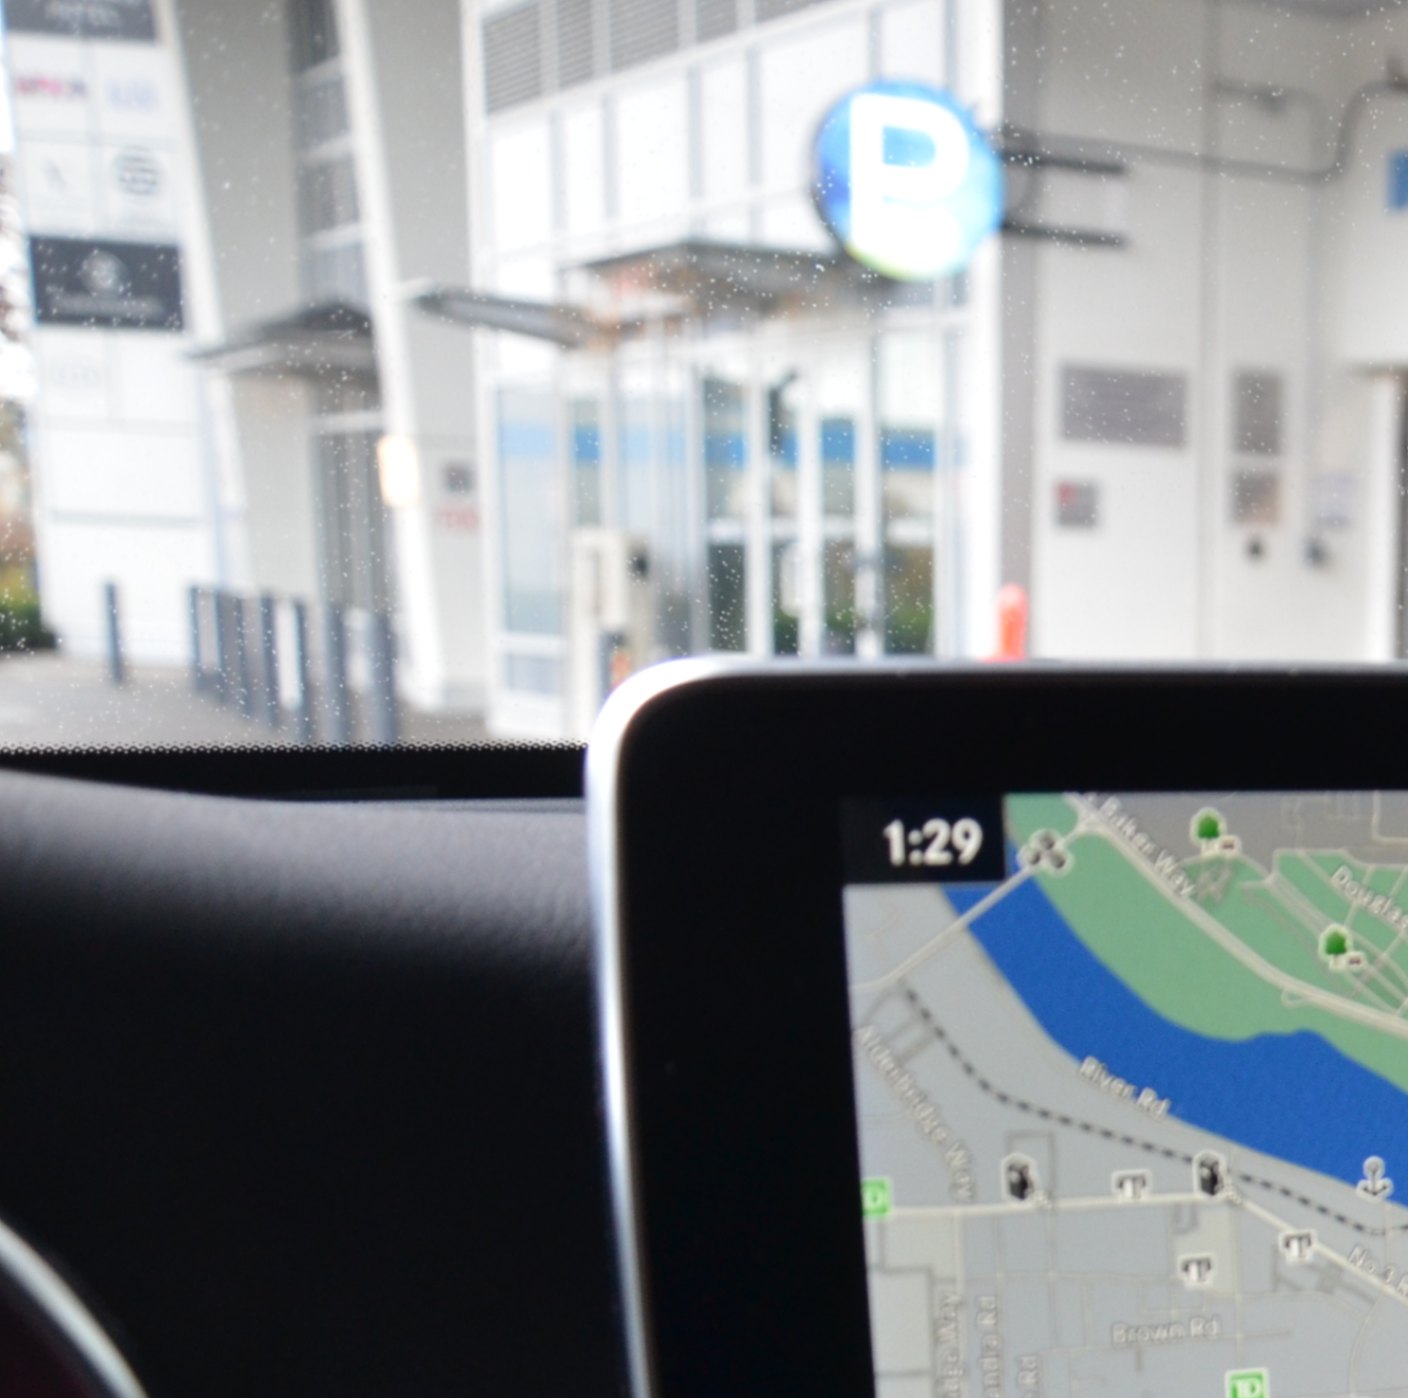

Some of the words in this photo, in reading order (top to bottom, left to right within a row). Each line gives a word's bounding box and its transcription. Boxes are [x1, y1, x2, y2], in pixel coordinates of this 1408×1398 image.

[883, 817, 983, 867] 1:29
[1154, 848, 1196, 897] Way
[1080, 1054, 1137, 1098] River
[1137, 1086, 1173, 1118] Rd
[1112, 1321, 1185, 1345] Brown
[1189, 1315, 1220, 1337] Rd
